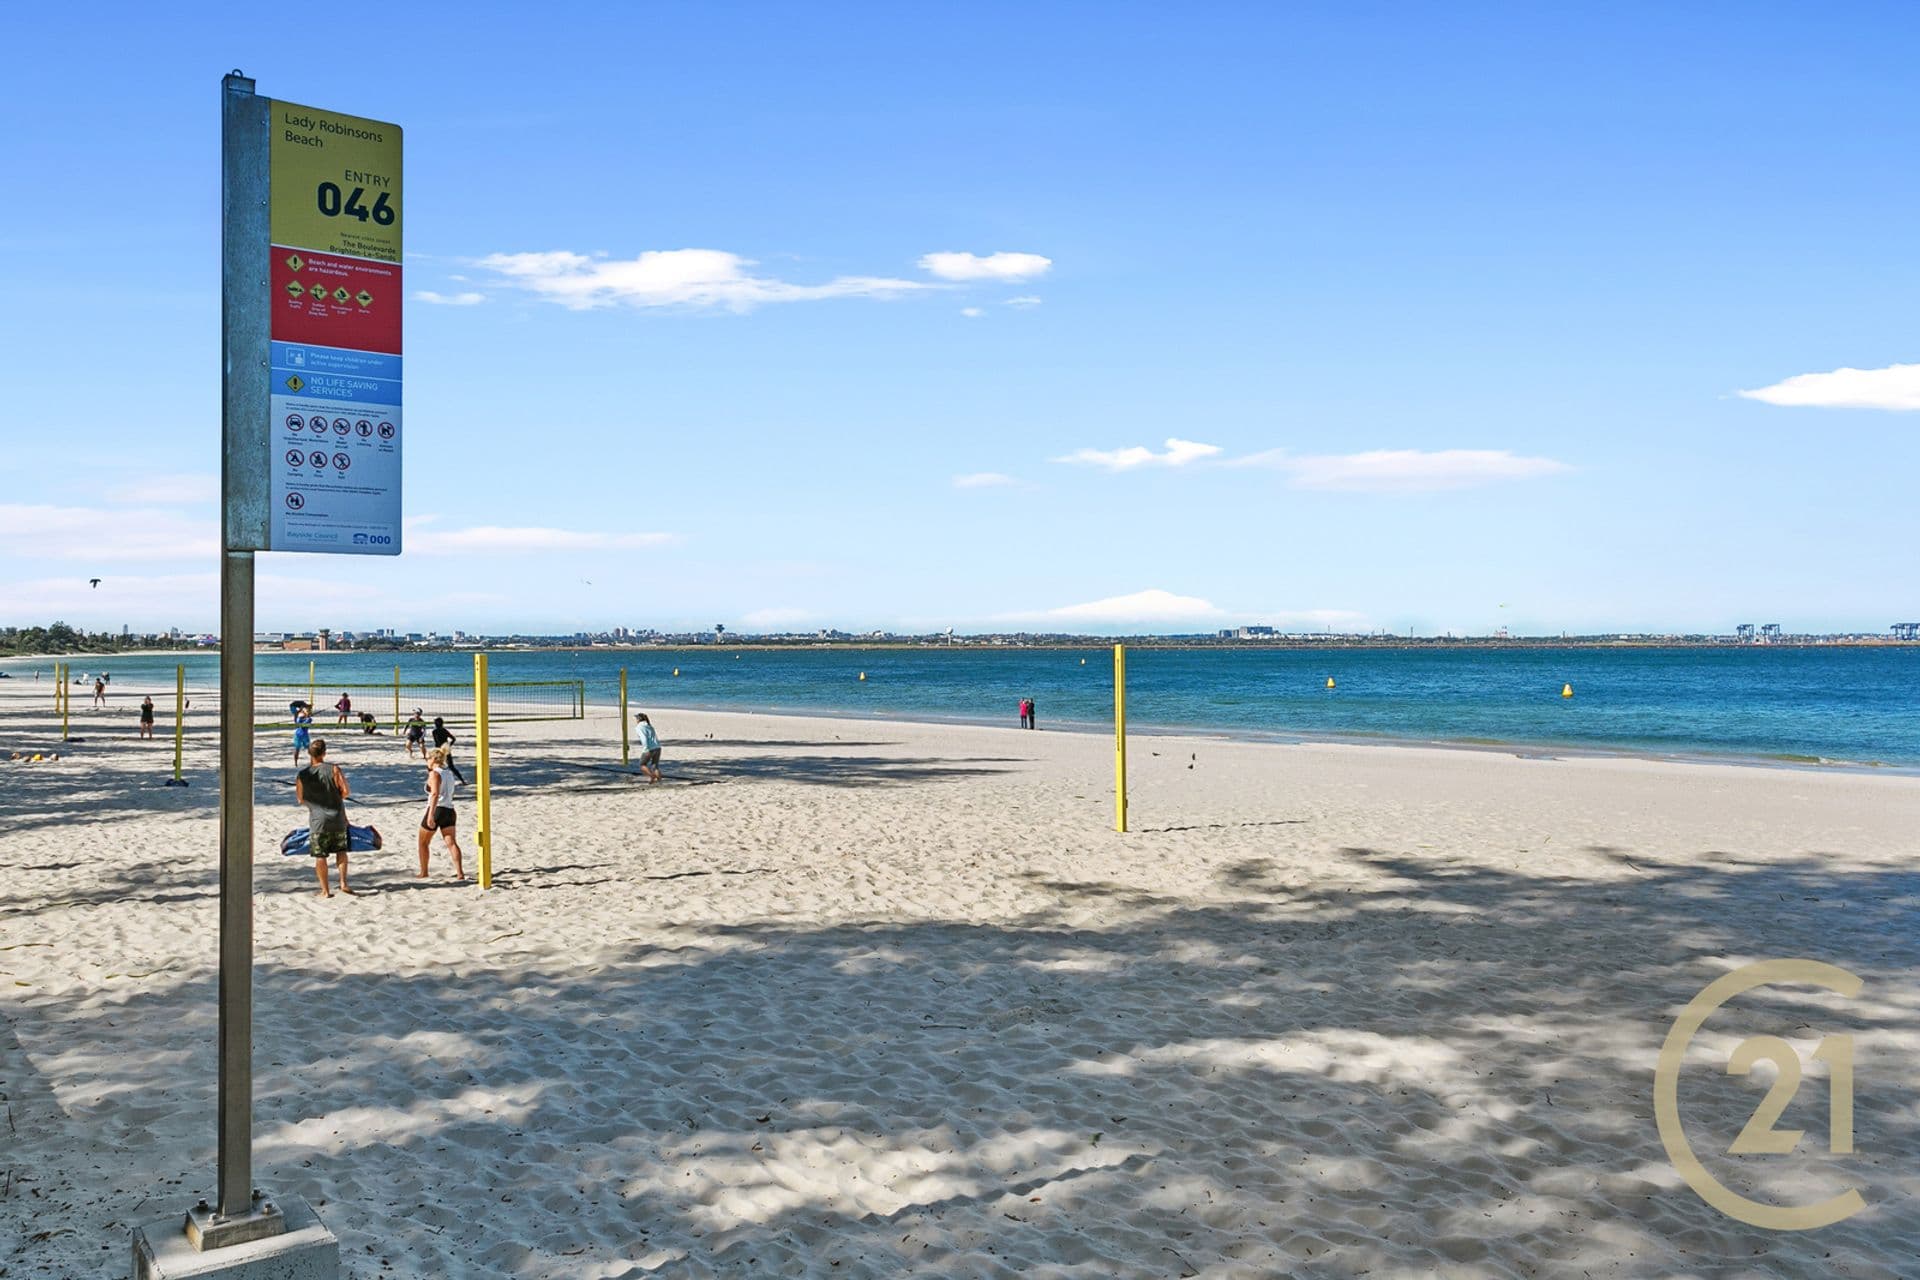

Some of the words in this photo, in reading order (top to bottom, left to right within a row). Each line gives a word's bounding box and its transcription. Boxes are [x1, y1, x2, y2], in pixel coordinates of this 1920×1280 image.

[285, 112, 316, 131] Lady
[320, 119, 383, 143] Robinsons
[285, 130, 323, 148] Beach
[345, 169, 391, 188] ENTRY
[317, 182, 395, 226] 046
[343, 239, 356, 248] The
[308, 258, 326, 267] Beach
[310, 377, 324, 386] NO
[326, 378, 345, 388] LIFE
[347, 380, 378, 391] SAVING
[310, 386, 353, 397] SERVICES
[370, 535, 391, 545] 000
